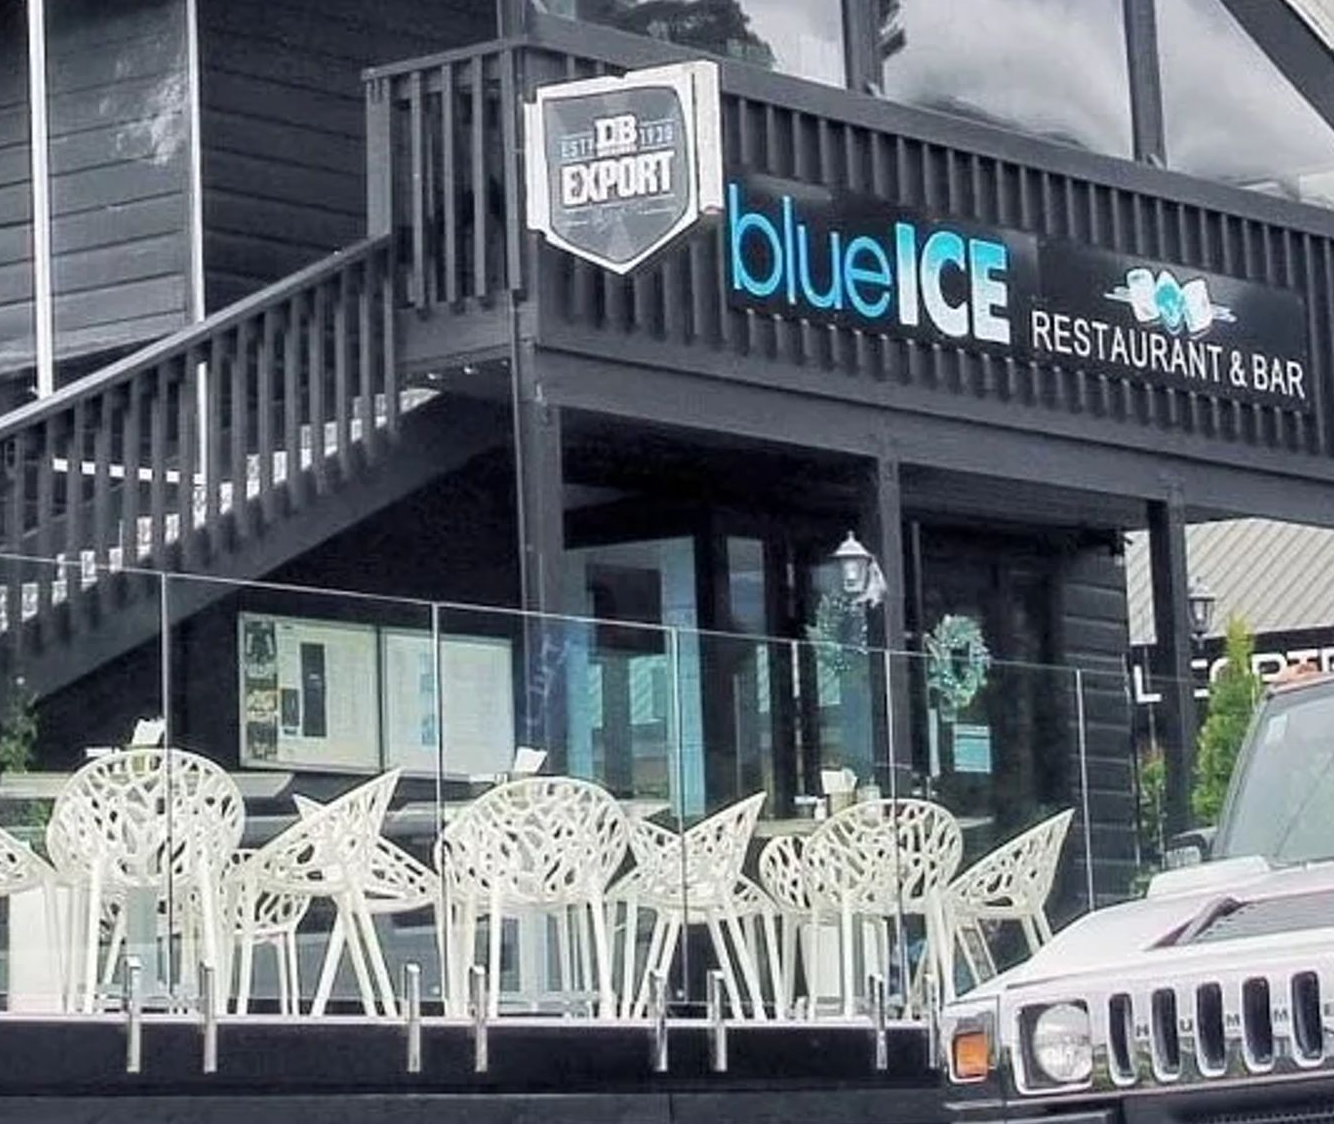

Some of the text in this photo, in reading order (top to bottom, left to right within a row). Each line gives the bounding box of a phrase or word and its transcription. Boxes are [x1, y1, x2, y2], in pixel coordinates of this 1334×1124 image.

[595, 115, 637, 147] DB
[562, 150, 675, 206] EXPORT
[1031, 310, 1307, 399] RESTAURANT & BAR
